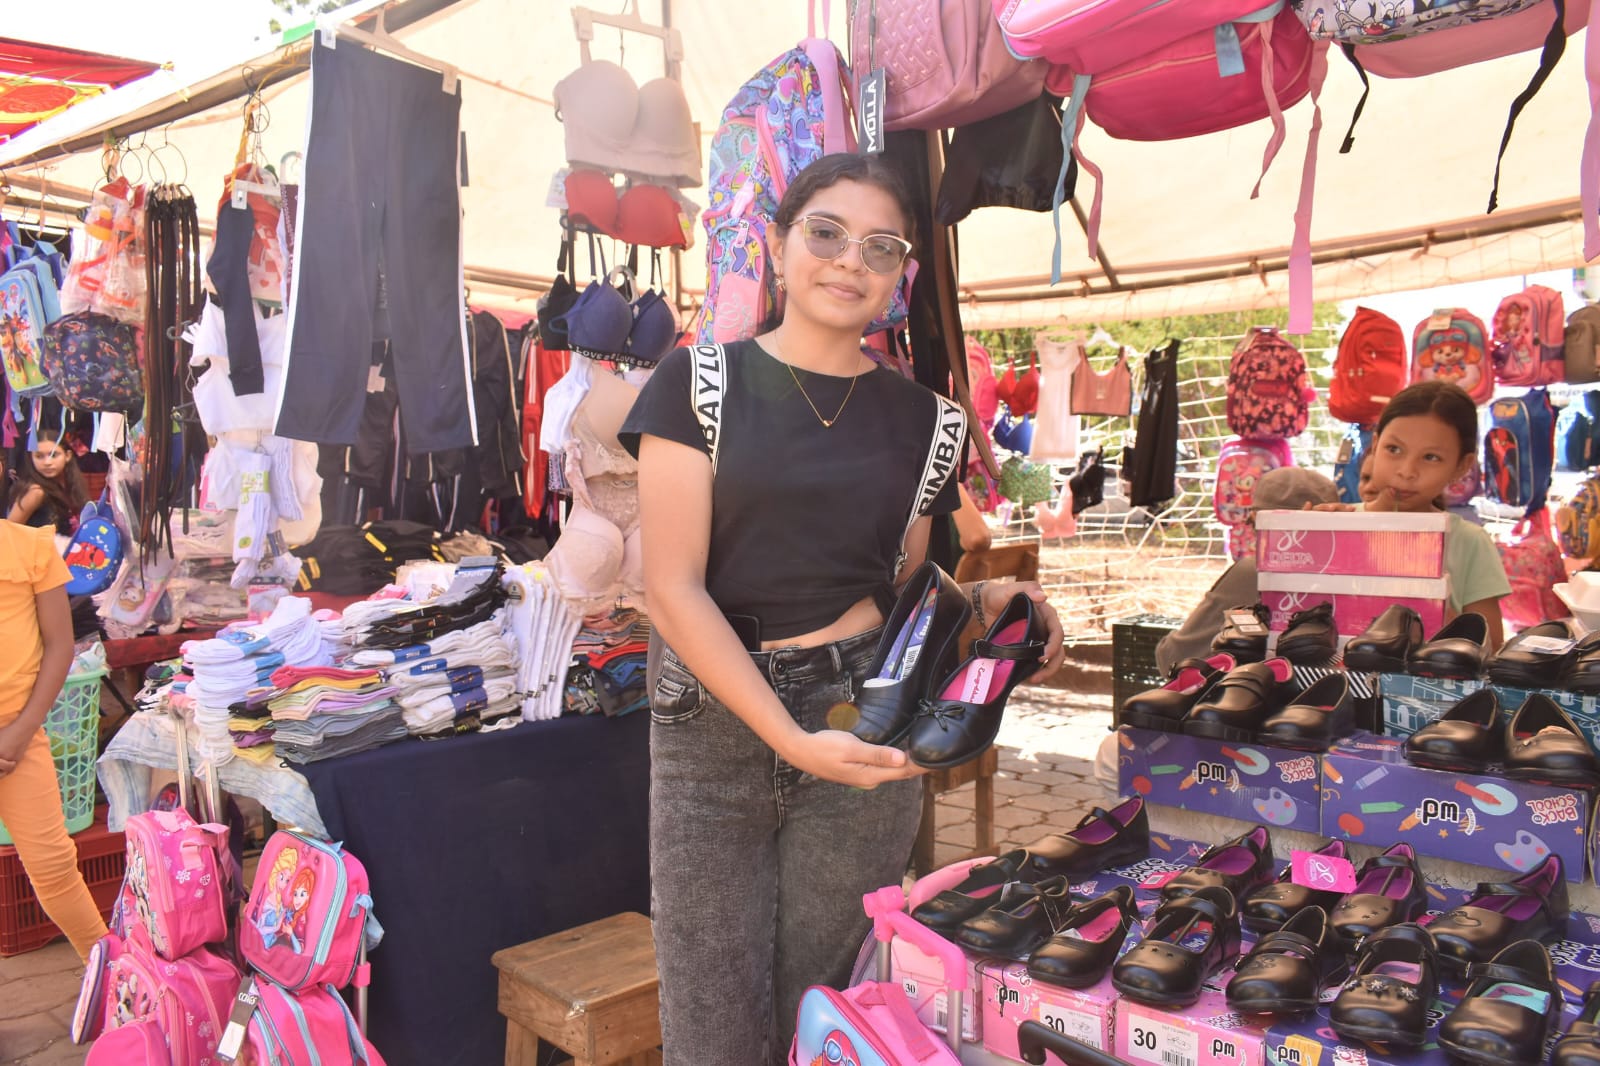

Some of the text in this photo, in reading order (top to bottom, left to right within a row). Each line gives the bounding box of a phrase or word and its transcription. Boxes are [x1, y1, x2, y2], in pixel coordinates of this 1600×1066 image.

[576, 346, 601, 360] LOVE
[697, 345, 720, 463] BAYLO
[1198, 762, 1225, 783] pm
[1277, 757, 1314, 772] SCHOOL
[1287, 766, 1315, 782] BACK
[1422, 799, 1459, 824] pm
[1527, 794, 1576, 812] SCHOOL
[1539, 806, 1577, 824] BACK
[905, 983, 916, 994] 30
[1044, 1015, 1065, 1034] 30
[1133, 1027, 1157, 1050] 30
[1213, 1039, 1235, 1057] pm
[1277, 1045, 1300, 1063] pm
